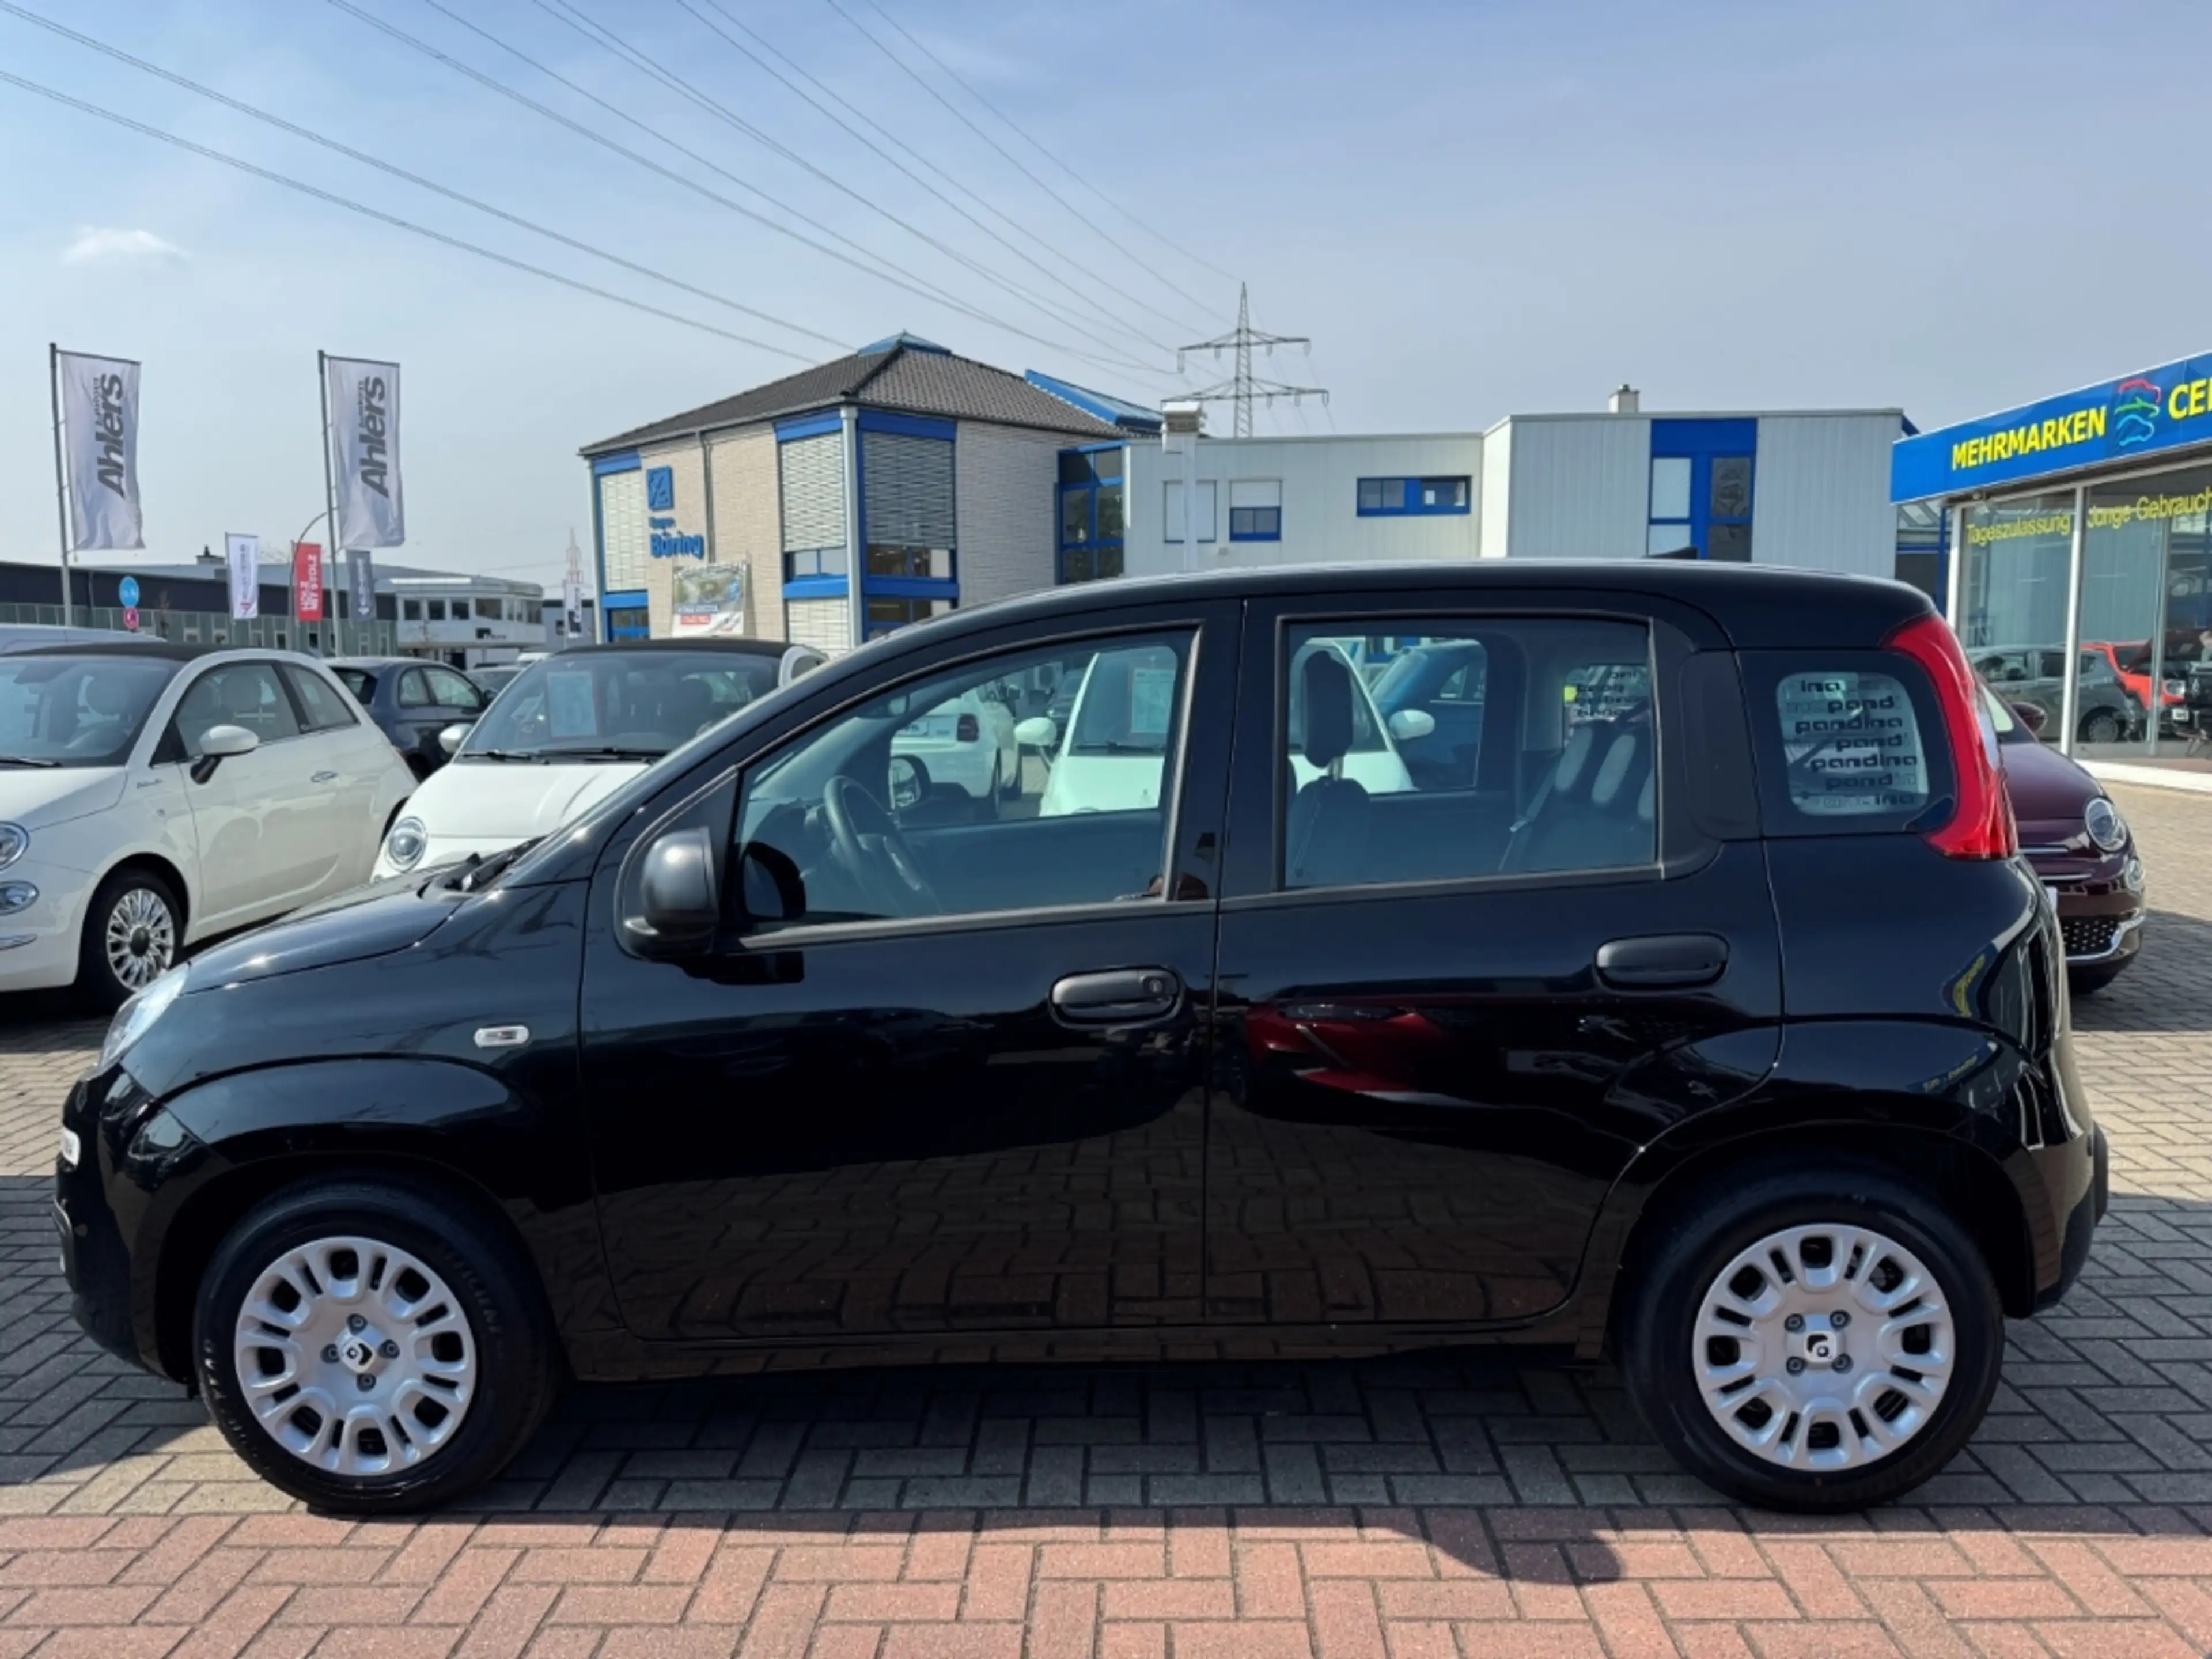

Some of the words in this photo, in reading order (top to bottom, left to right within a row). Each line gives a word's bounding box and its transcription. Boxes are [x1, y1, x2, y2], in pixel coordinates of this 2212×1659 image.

[95, 373, 125, 499] Ahlers
[359, 376, 389, 499] Ahlers
[1952, 405, 2107, 471] MEHRMARKEN
[2168, 376, 2212, 420] CE
[1795, 716, 1902, 734] pandina
[1810, 754, 1918, 772] pandina
